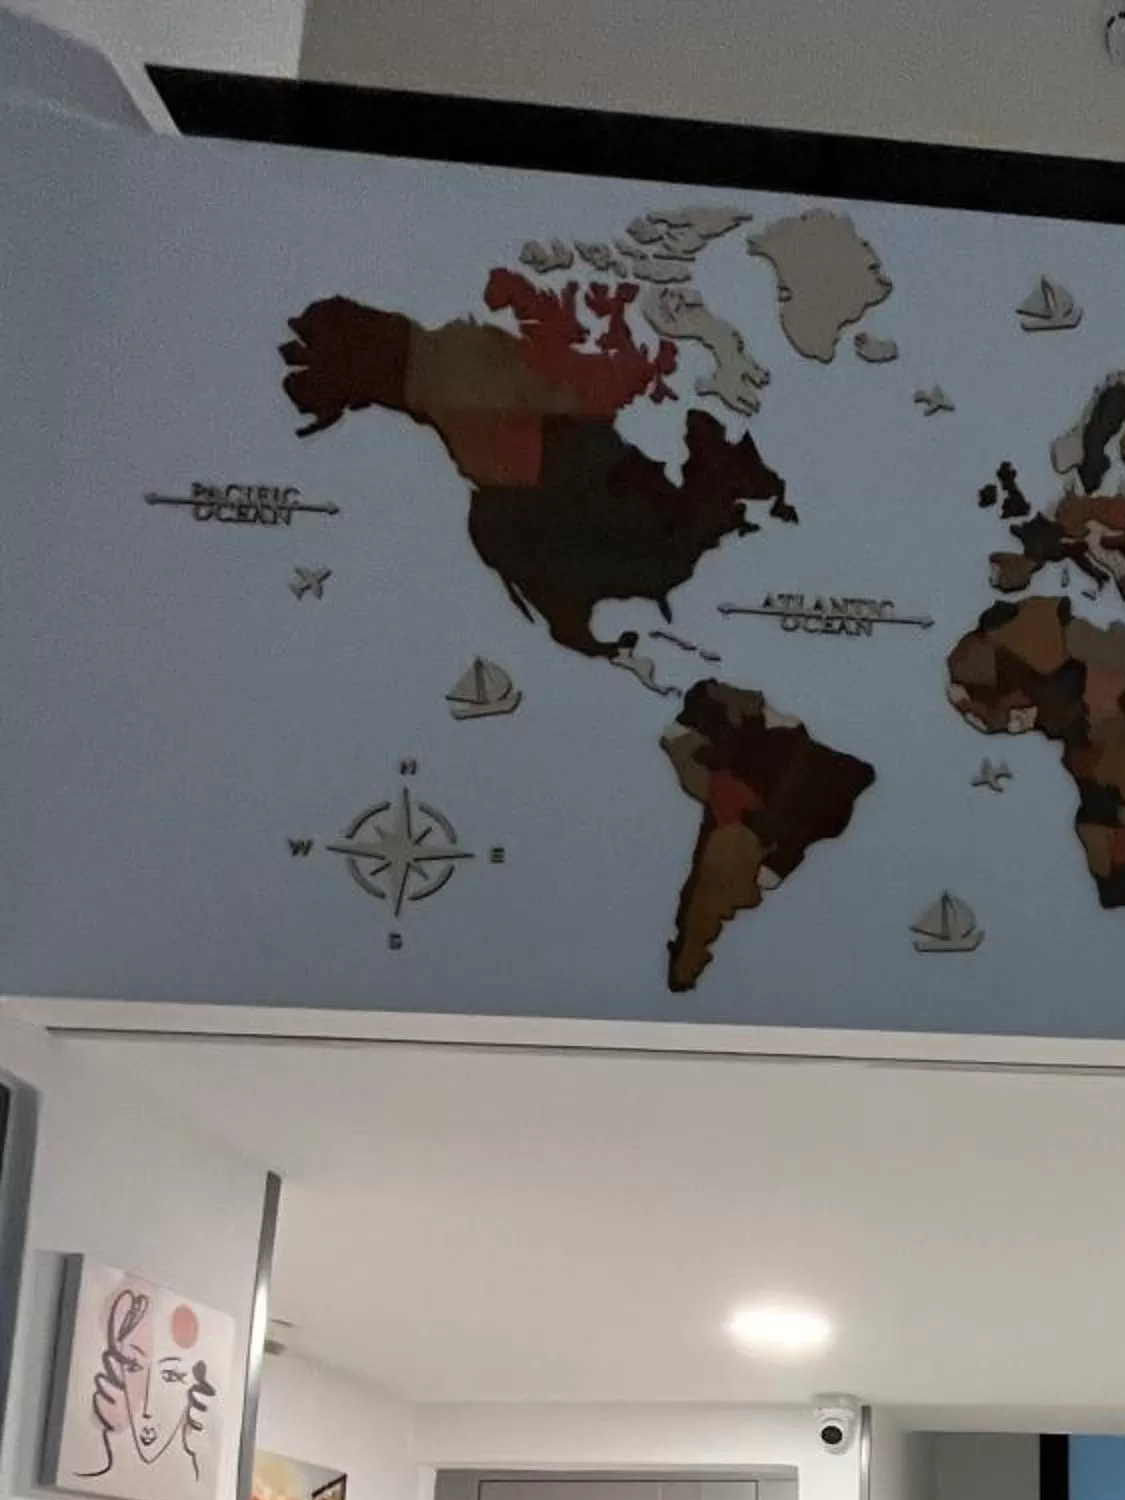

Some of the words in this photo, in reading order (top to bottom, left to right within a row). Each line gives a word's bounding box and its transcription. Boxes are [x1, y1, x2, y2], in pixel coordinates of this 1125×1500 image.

[193, 502, 292, 526] OCEAN
[762, 593, 896, 618] ATLANTIC
[780, 615, 874, 637] OCEAN
[289, 838, 314, 857] W
